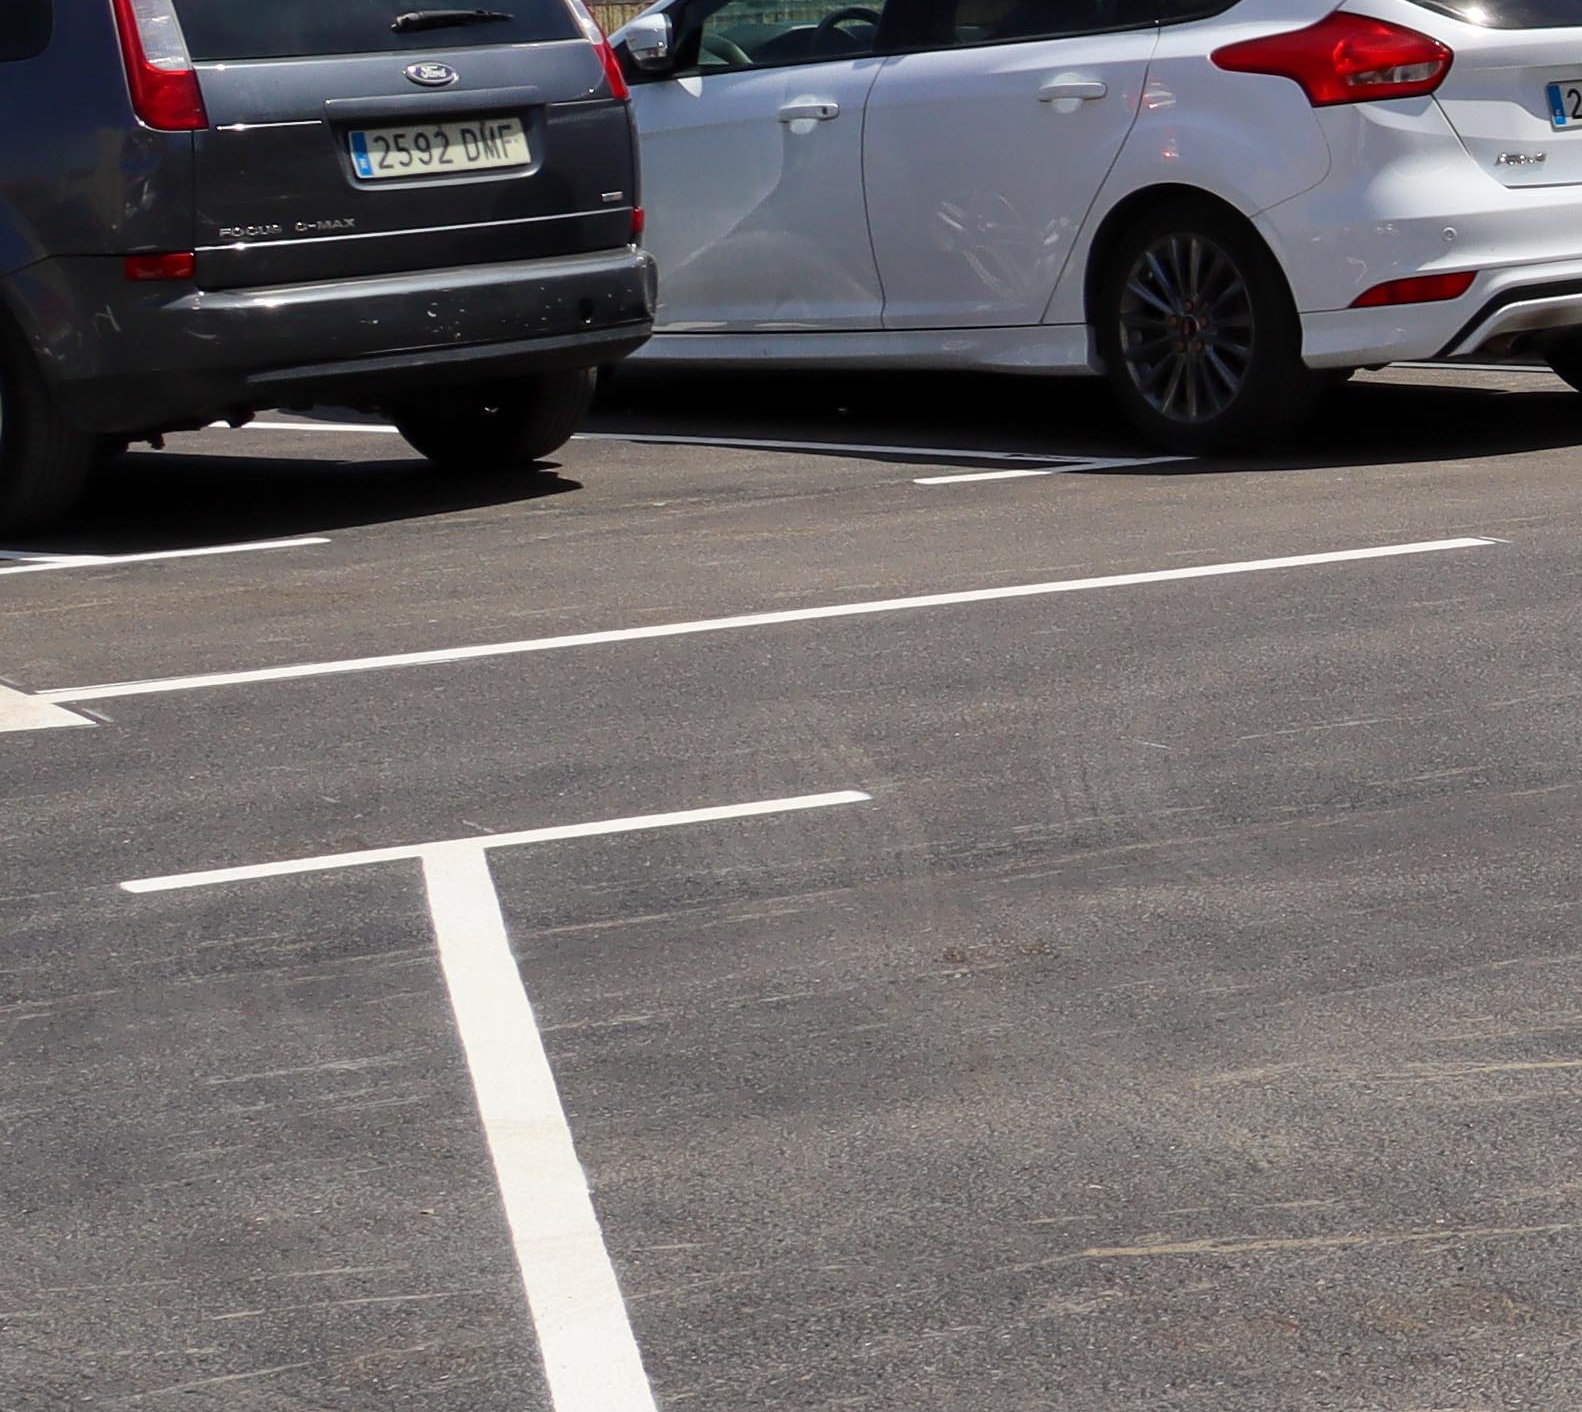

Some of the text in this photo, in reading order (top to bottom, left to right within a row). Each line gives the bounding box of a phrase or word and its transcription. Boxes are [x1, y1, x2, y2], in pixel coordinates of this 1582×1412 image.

[373, 124, 513, 170] 2592 DMF
[219, 223, 282, 237] FOCUS
